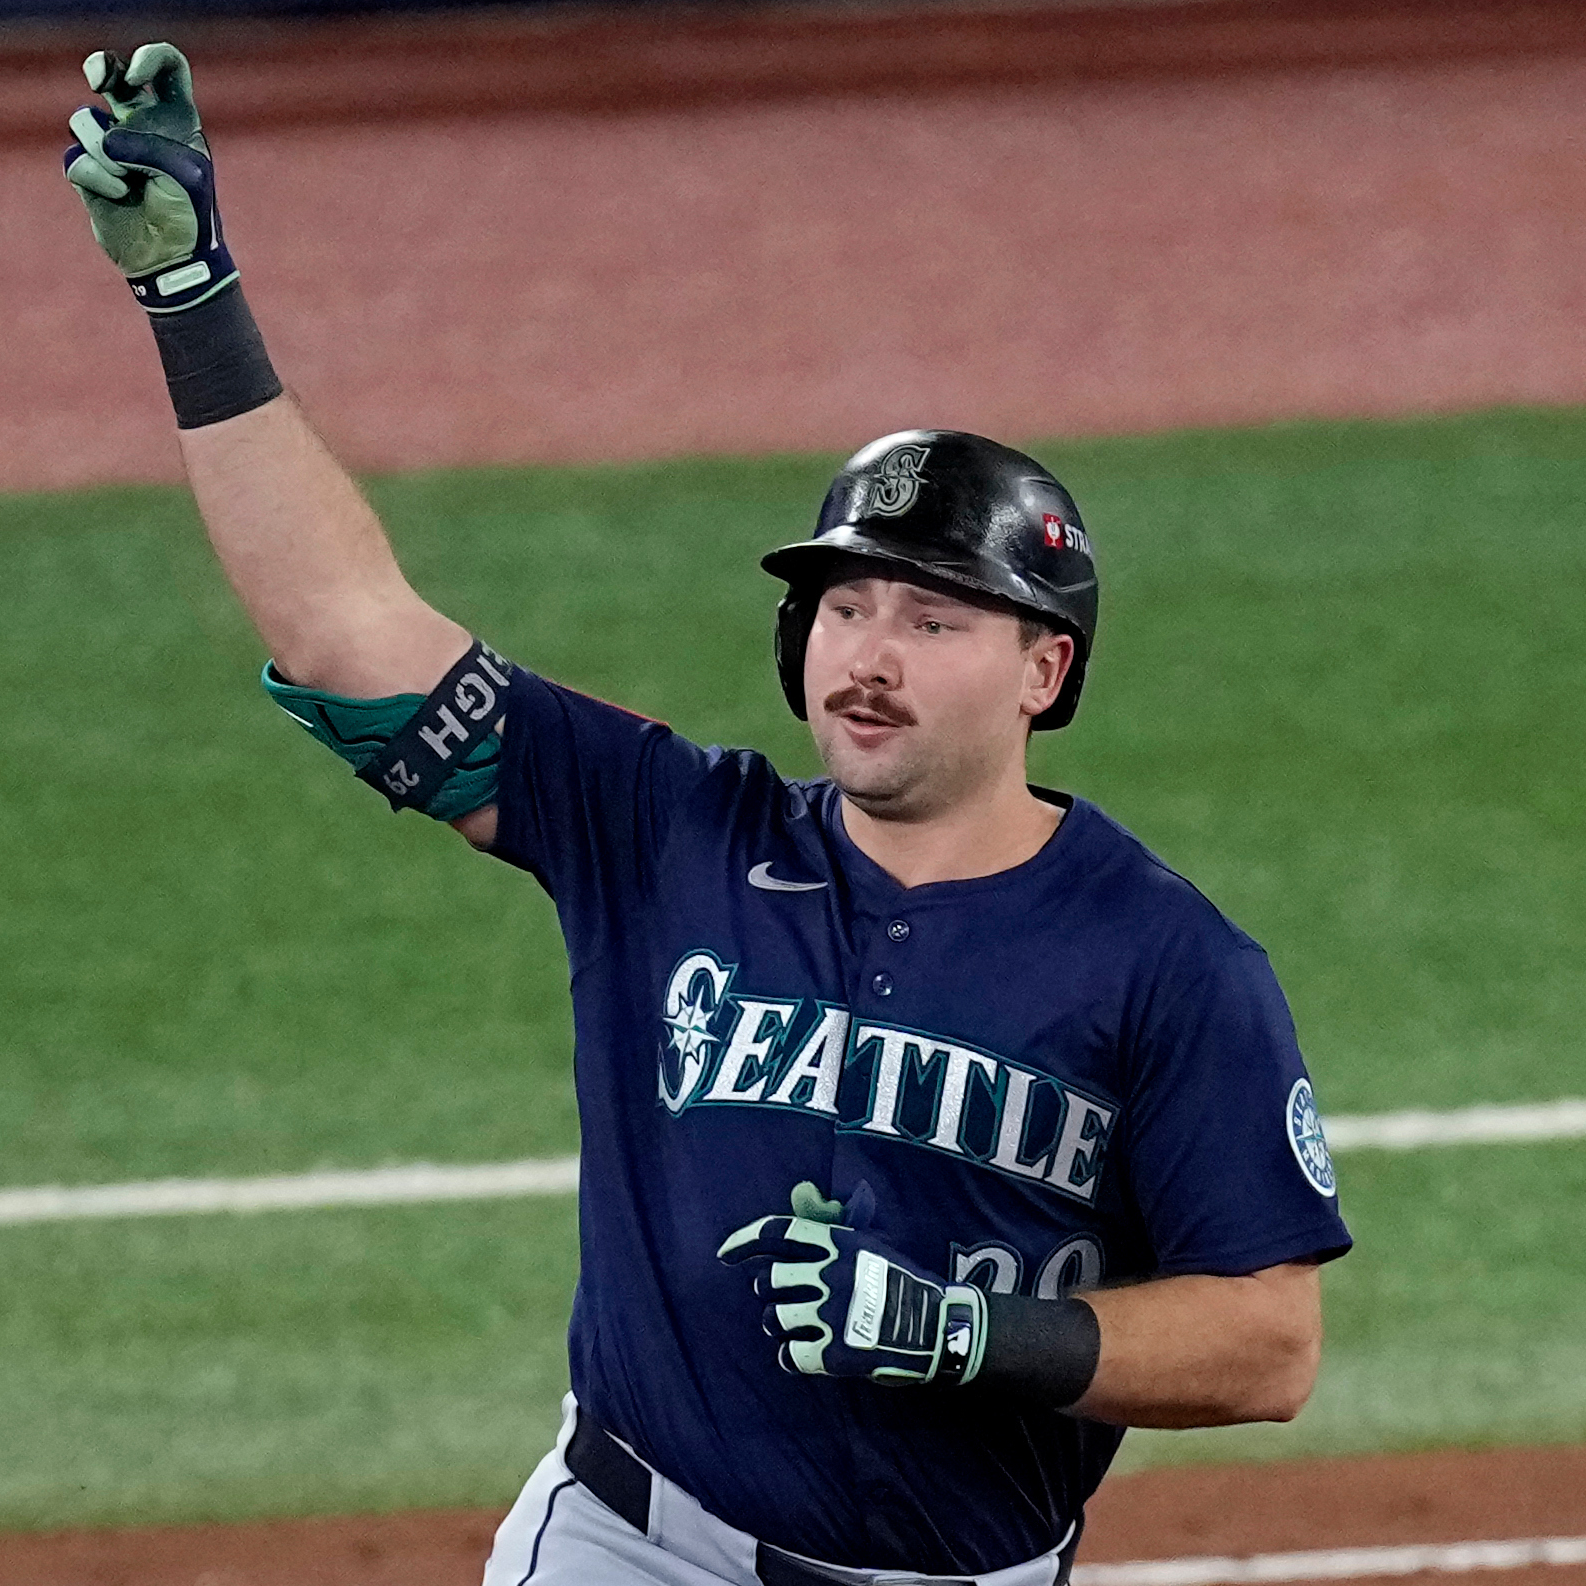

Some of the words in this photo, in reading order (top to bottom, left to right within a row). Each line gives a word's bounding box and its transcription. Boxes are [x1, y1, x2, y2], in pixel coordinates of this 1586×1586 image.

[383, 759, 420, 796] 29
[658, 948, 1122, 1205] SEATTLE
[852, 1258, 881, 1342] Franklin
